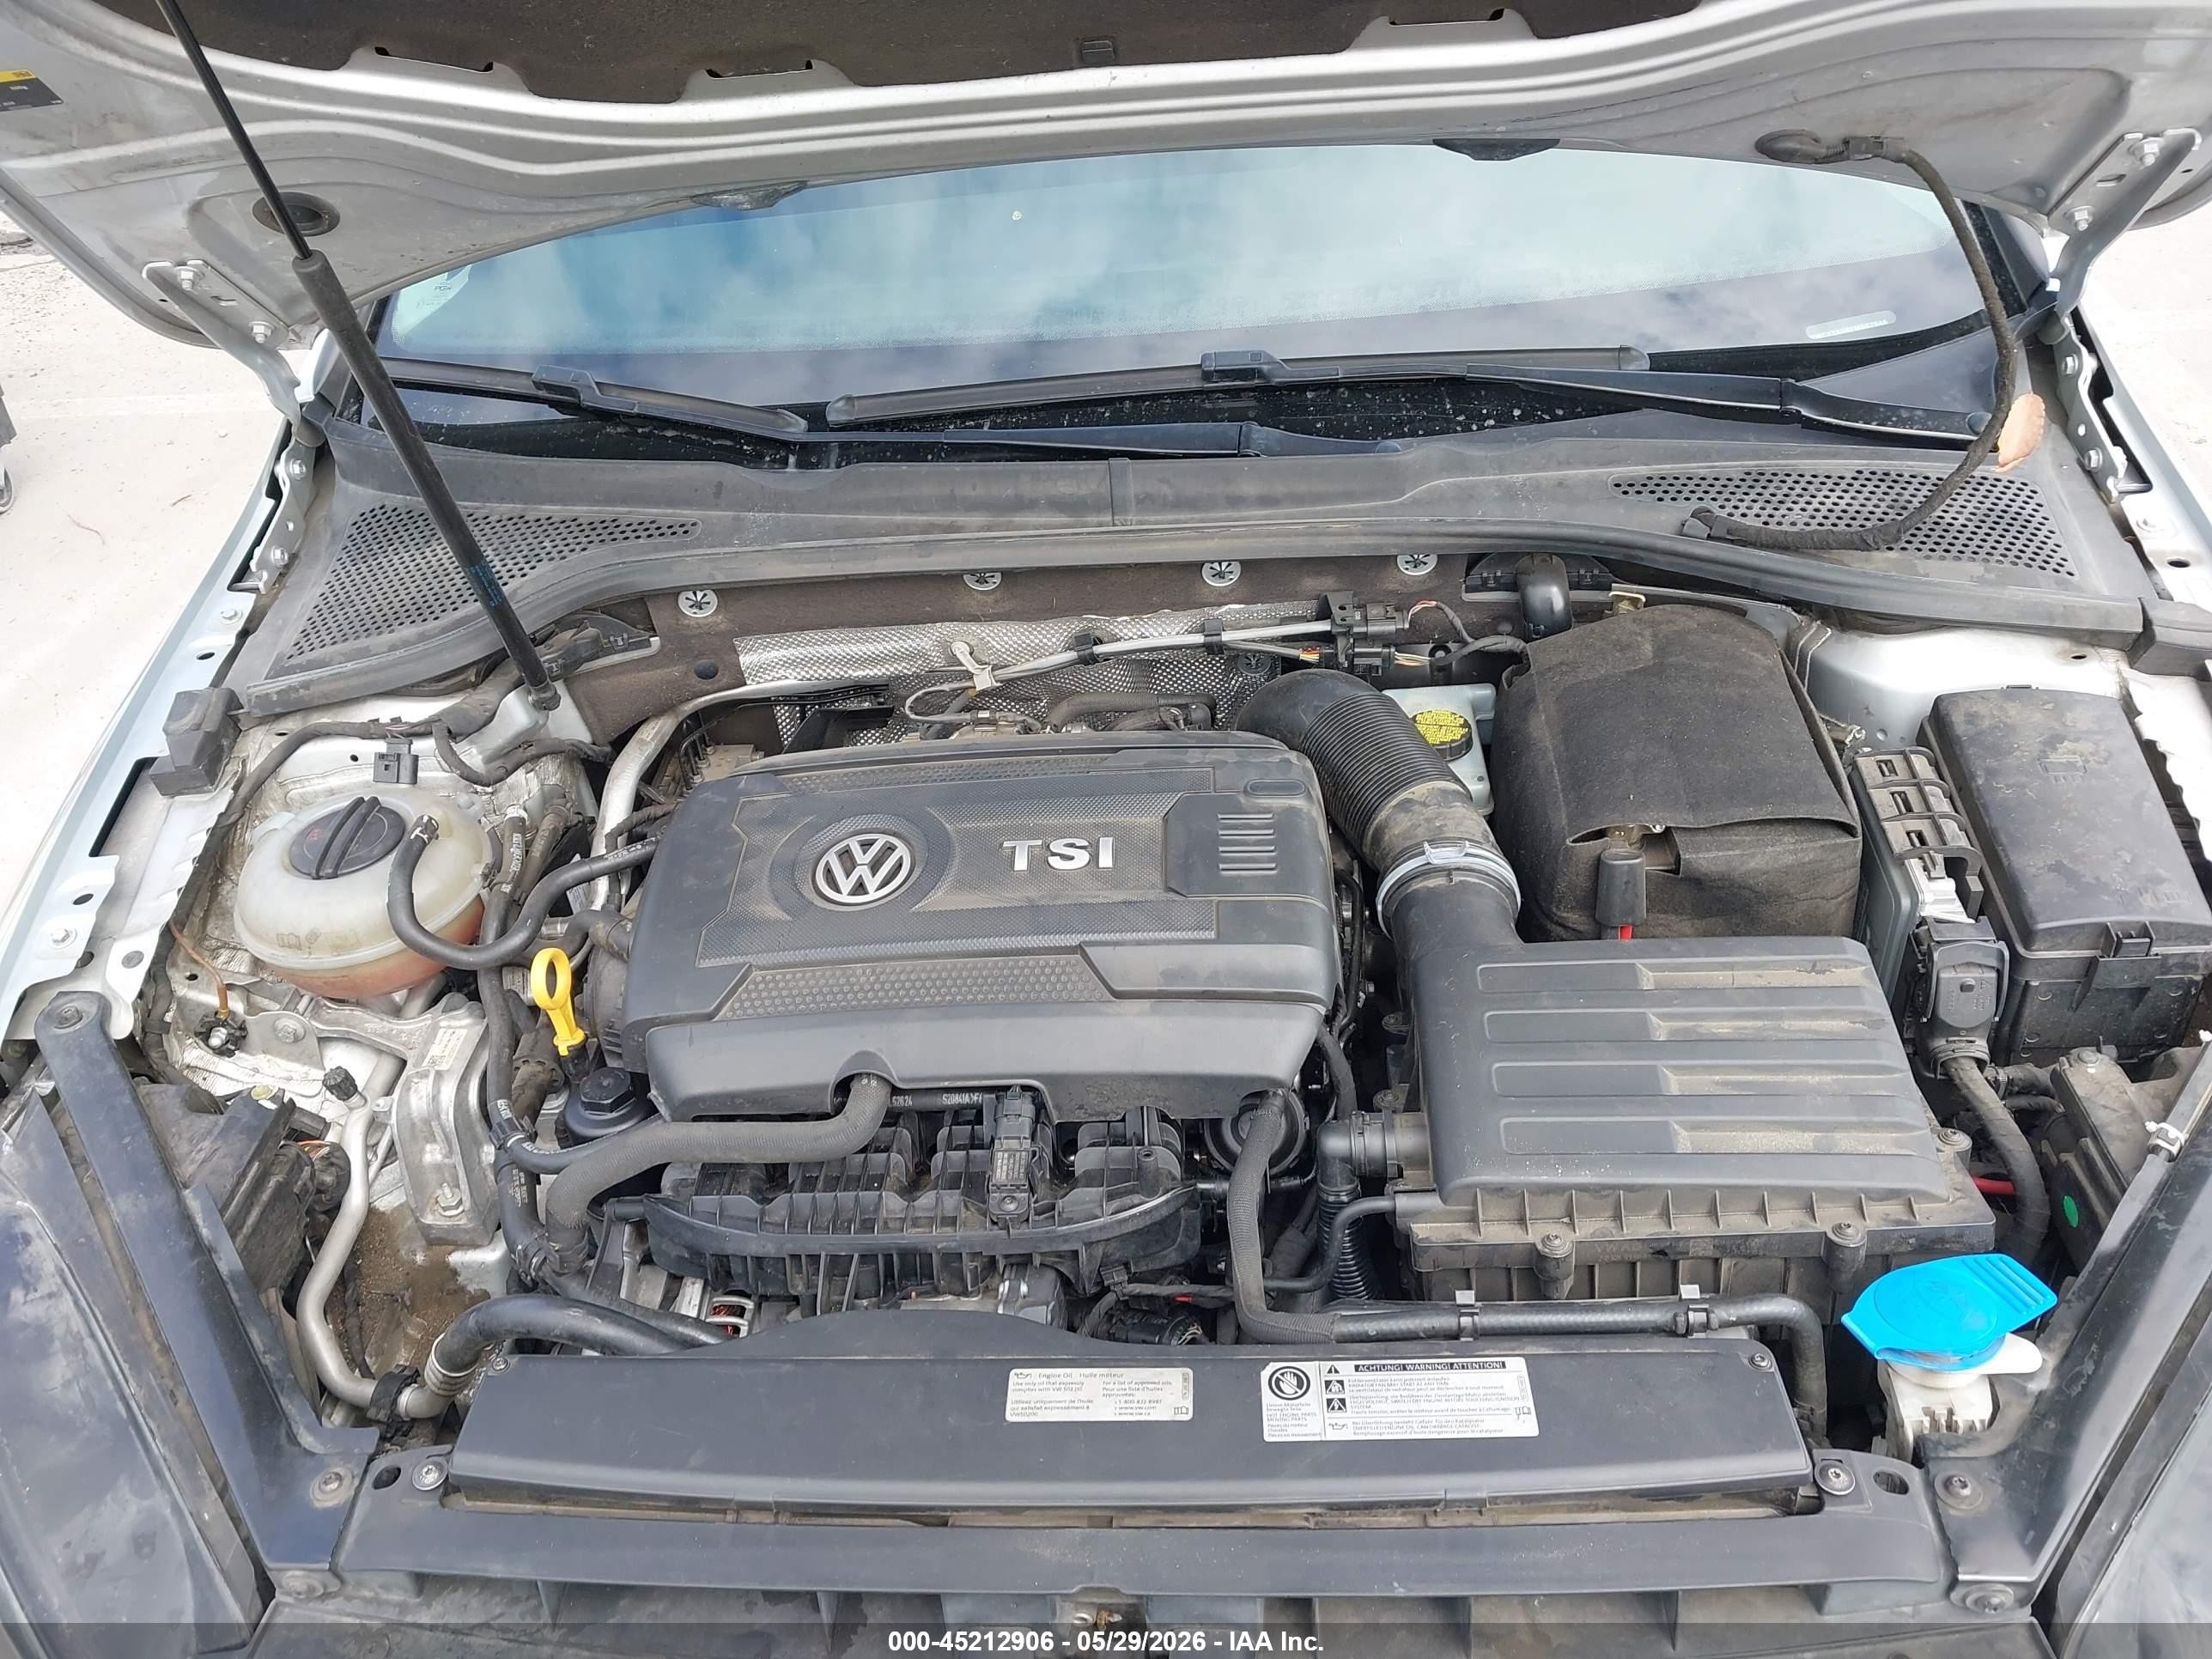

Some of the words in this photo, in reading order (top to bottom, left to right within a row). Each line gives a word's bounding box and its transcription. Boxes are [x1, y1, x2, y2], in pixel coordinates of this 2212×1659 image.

[1001, 836, 1114, 872] TSI
[1405, 1363, 1451, 1371] WARNING!
[1452, 1361, 1504, 1370] ATTENTION!
